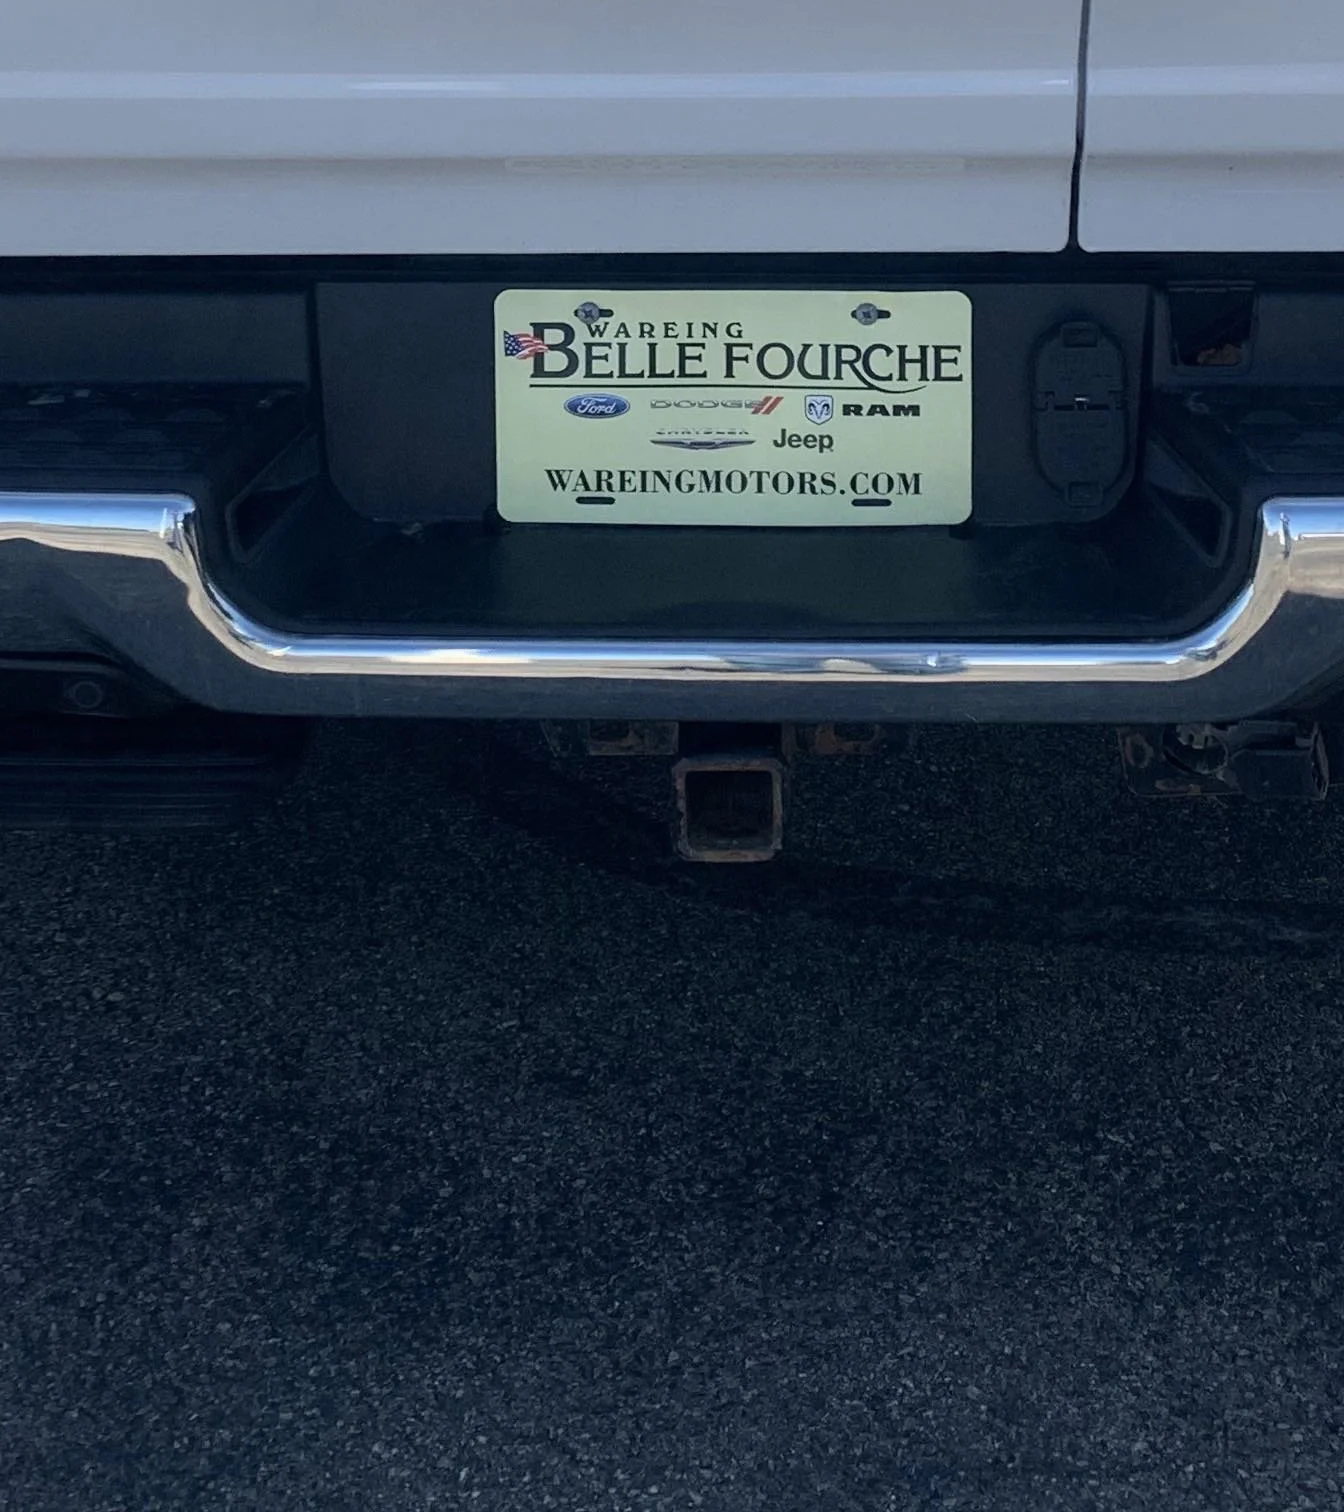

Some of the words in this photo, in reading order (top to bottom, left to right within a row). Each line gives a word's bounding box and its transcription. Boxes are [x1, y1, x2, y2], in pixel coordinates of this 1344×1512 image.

[587, 321, 745, 339] WAREING
[576, 397, 617, 414] Ford
[842, 403, 921, 417] RAM
[773, 428, 834, 452] Jeep
[544, 469, 923, 496] WAREINGMOTORS.COM
